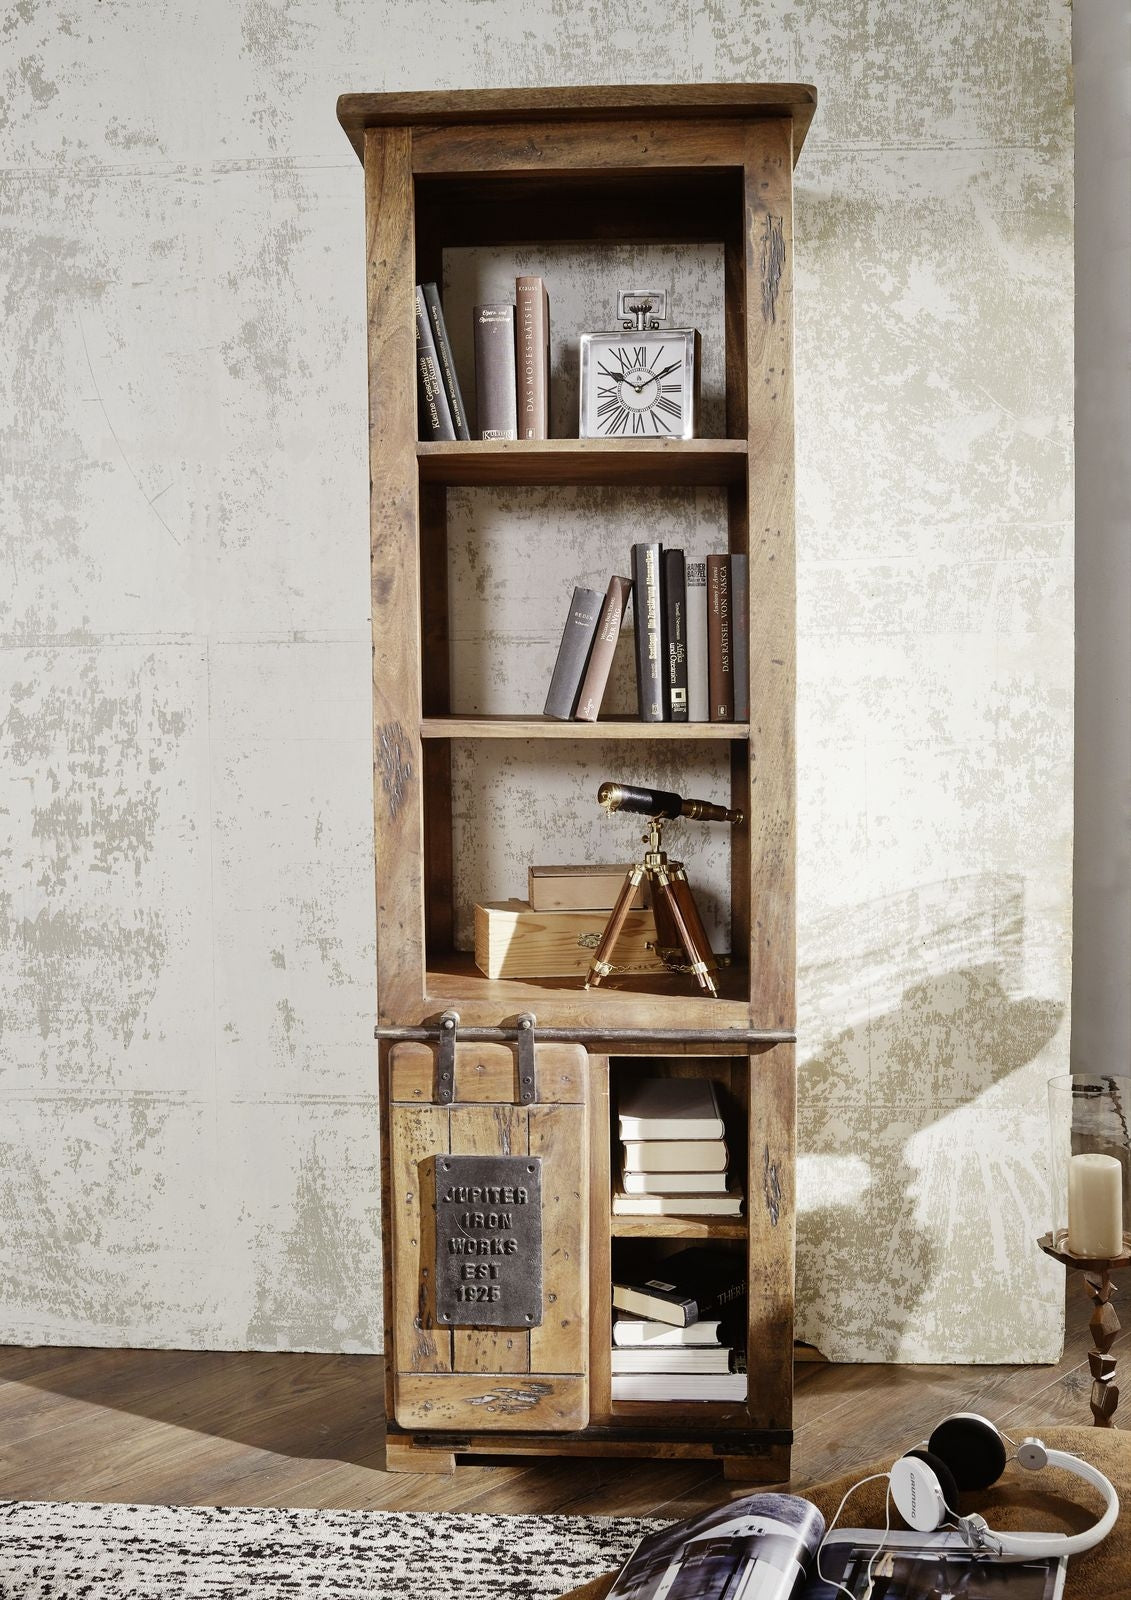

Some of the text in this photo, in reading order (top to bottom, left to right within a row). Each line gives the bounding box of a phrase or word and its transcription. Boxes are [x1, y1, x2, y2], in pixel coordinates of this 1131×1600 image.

[426, 356, 440, 395] der Kunst
[420, 357, 440, 429] Kleine Geschichte
[712, 589, 720, 614] Anthony
[606, 607, 621, 642] DER WEG
[720, 565, 729, 672] DAS RÄTSEL VON NASCA
[676, 642, 684, 663] Afrika
[670, 655, 678, 684] Ozeanien
[443, 1187, 528, 1204] JUPITER
[462, 1212, 512, 1229] IRON
[449, 1238, 518, 1255] WORKS
[461, 1263, 501, 1279] EST
[456, 1285, 500, 1302] 1925
